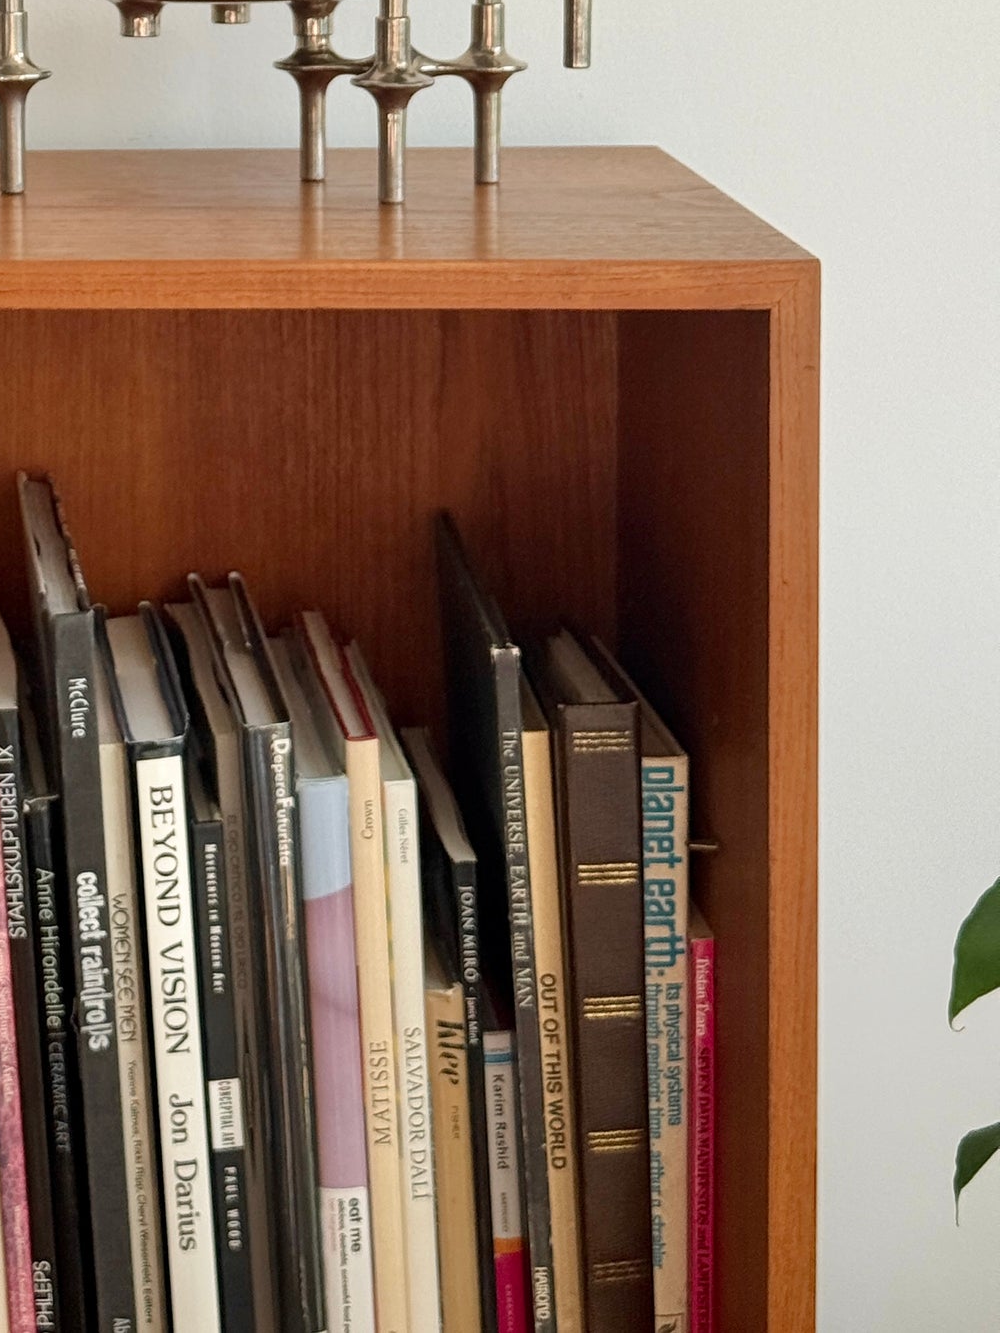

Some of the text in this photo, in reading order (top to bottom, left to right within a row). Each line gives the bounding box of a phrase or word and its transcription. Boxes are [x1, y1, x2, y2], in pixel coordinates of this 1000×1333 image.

[269, 737, 295, 868] DeperoFuturista
[360, 798, 375, 840] Crown
[397, 807, 410, 837] Gilles
[642, 766, 685, 870] planet
[67, 677, 114, 1052] McClure collect raindrops
[502, 727, 533, 1009] The UNIVERSE, EARTH and MAN
[112, 893, 136, 963] WOMEN
[458, 884, 475, 929] JOAN
[117, 966, 135, 1002] SEE
[461, 933, 481, 983] MIRÓ
[695, 956, 710, 1000] Tristan
[35, 867, 72, 1153] Anne Hirondelle CERAMIC ART
[119, 1004, 137, 1043] MEN
[149, 785, 201, 1252] BEYOND VISION Jon Darius
[695, 1002, 711, 1037] Tzara
[1, 1043, 12, 1061] Six
[127, 1059, 139, 1097] Yvonne
[435, 1018, 466, 1086] Klee
[539, 973, 568, 1171] OUT OF THIS WORLD
[663, 982, 685, 1125] its physical systems
[697, 1046, 712, 1094] SEVEN
[2, 1064, 16, 1103] Artists
[368, 1042, 393, 1146] MATISSE
[403, 1026, 424, 1142] SALVADOR
[492, 1073, 512, 1170] Karim Rashid
[697, 1095, 713, 1135] DADA
[217, 1079, 243, 1251] CONCEPTUAL ART PAUL WOOD
[135, 1193, 149, 1227] Cheryl
[348, 1197, 363, 1253] eat me
[143, 1287, 155, 1324] Editors
